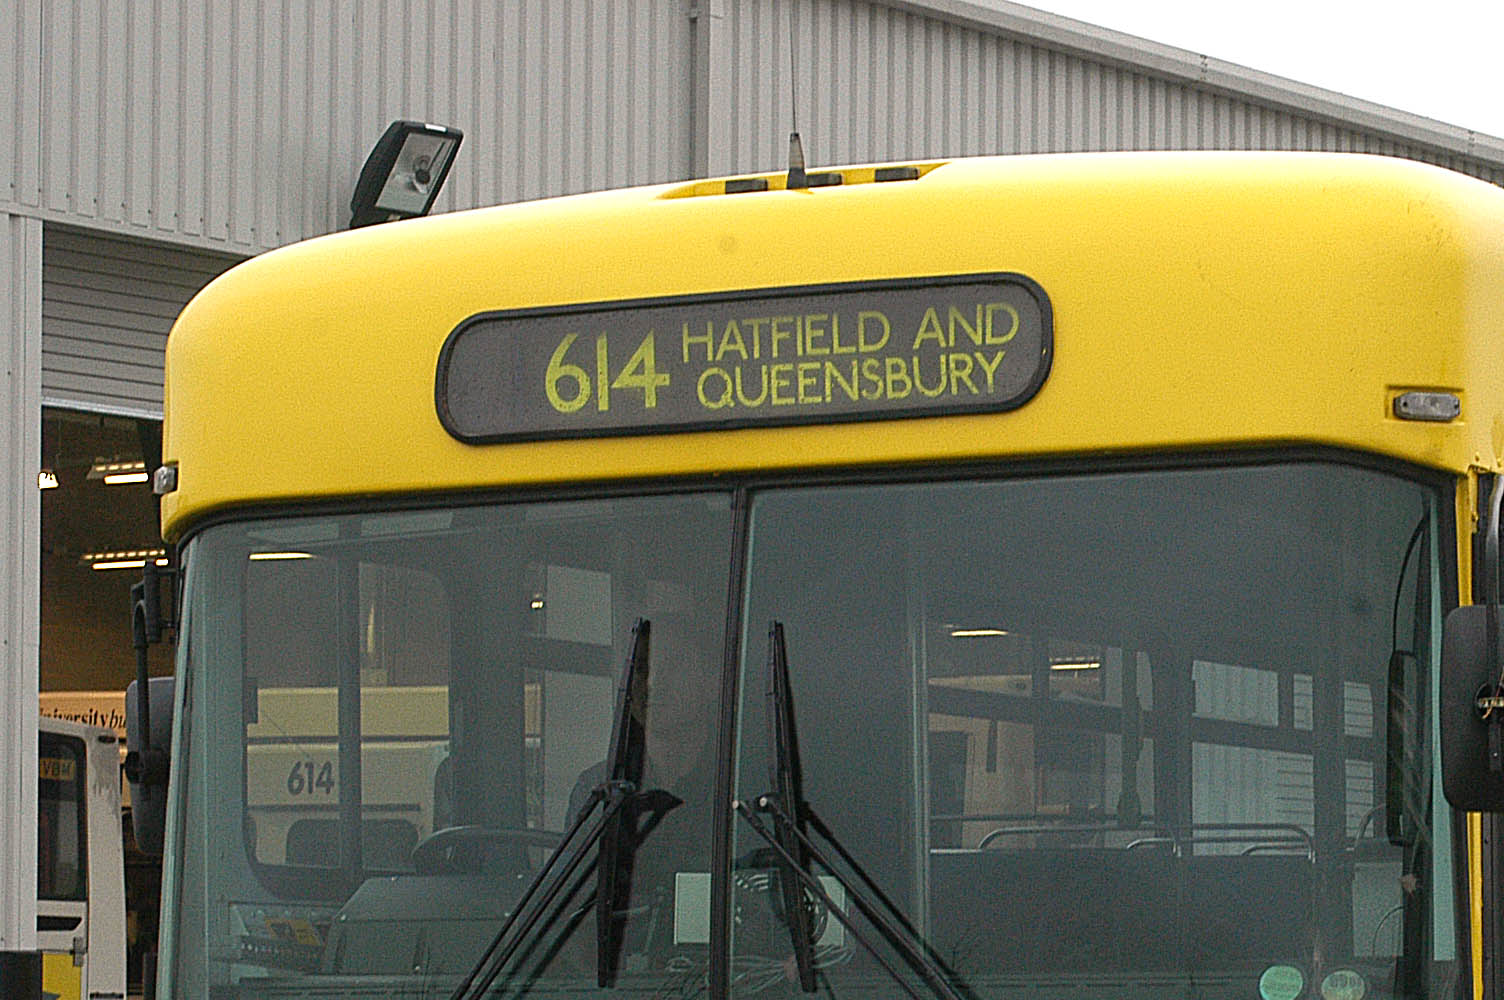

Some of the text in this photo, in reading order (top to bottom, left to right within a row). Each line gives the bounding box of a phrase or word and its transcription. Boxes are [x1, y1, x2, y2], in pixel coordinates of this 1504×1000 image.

[682, 302, 1021, 364] HATFIELD AND
[544, 329, 671, 413] 614
[696, 350, 1007, 411] QUEENSBURY
[287, 760, 336, 796] 614
